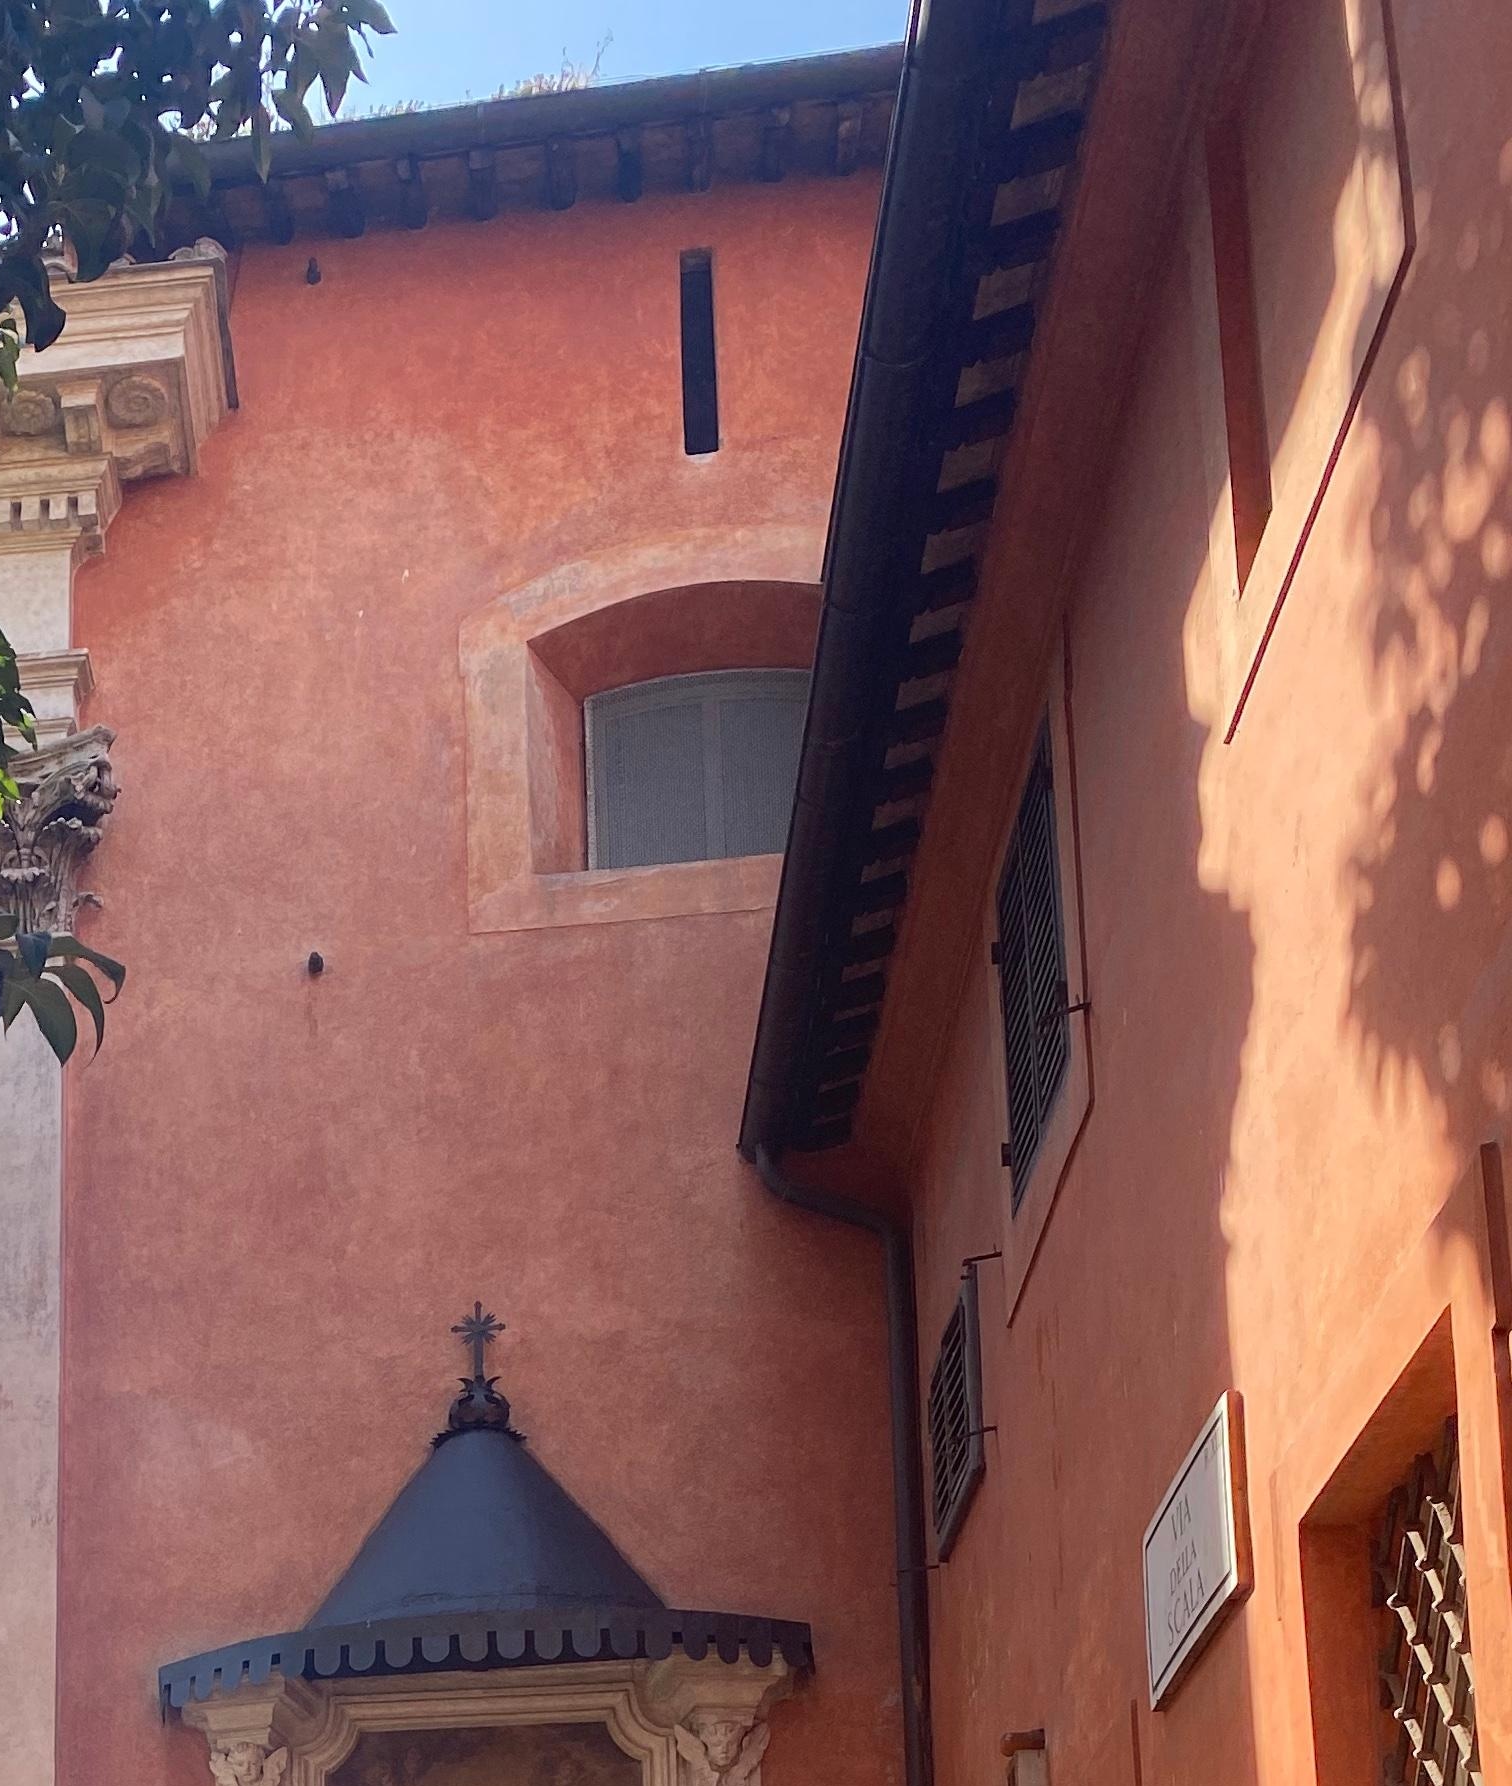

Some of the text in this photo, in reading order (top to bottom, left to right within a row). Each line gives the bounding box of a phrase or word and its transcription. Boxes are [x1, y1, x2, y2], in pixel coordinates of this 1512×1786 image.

[1171, 1494, 1192, 1542] VIA
[1169, 1539, 1197, 1594] DELLA
[1167, 1568, 1205, 1647] SCALA
